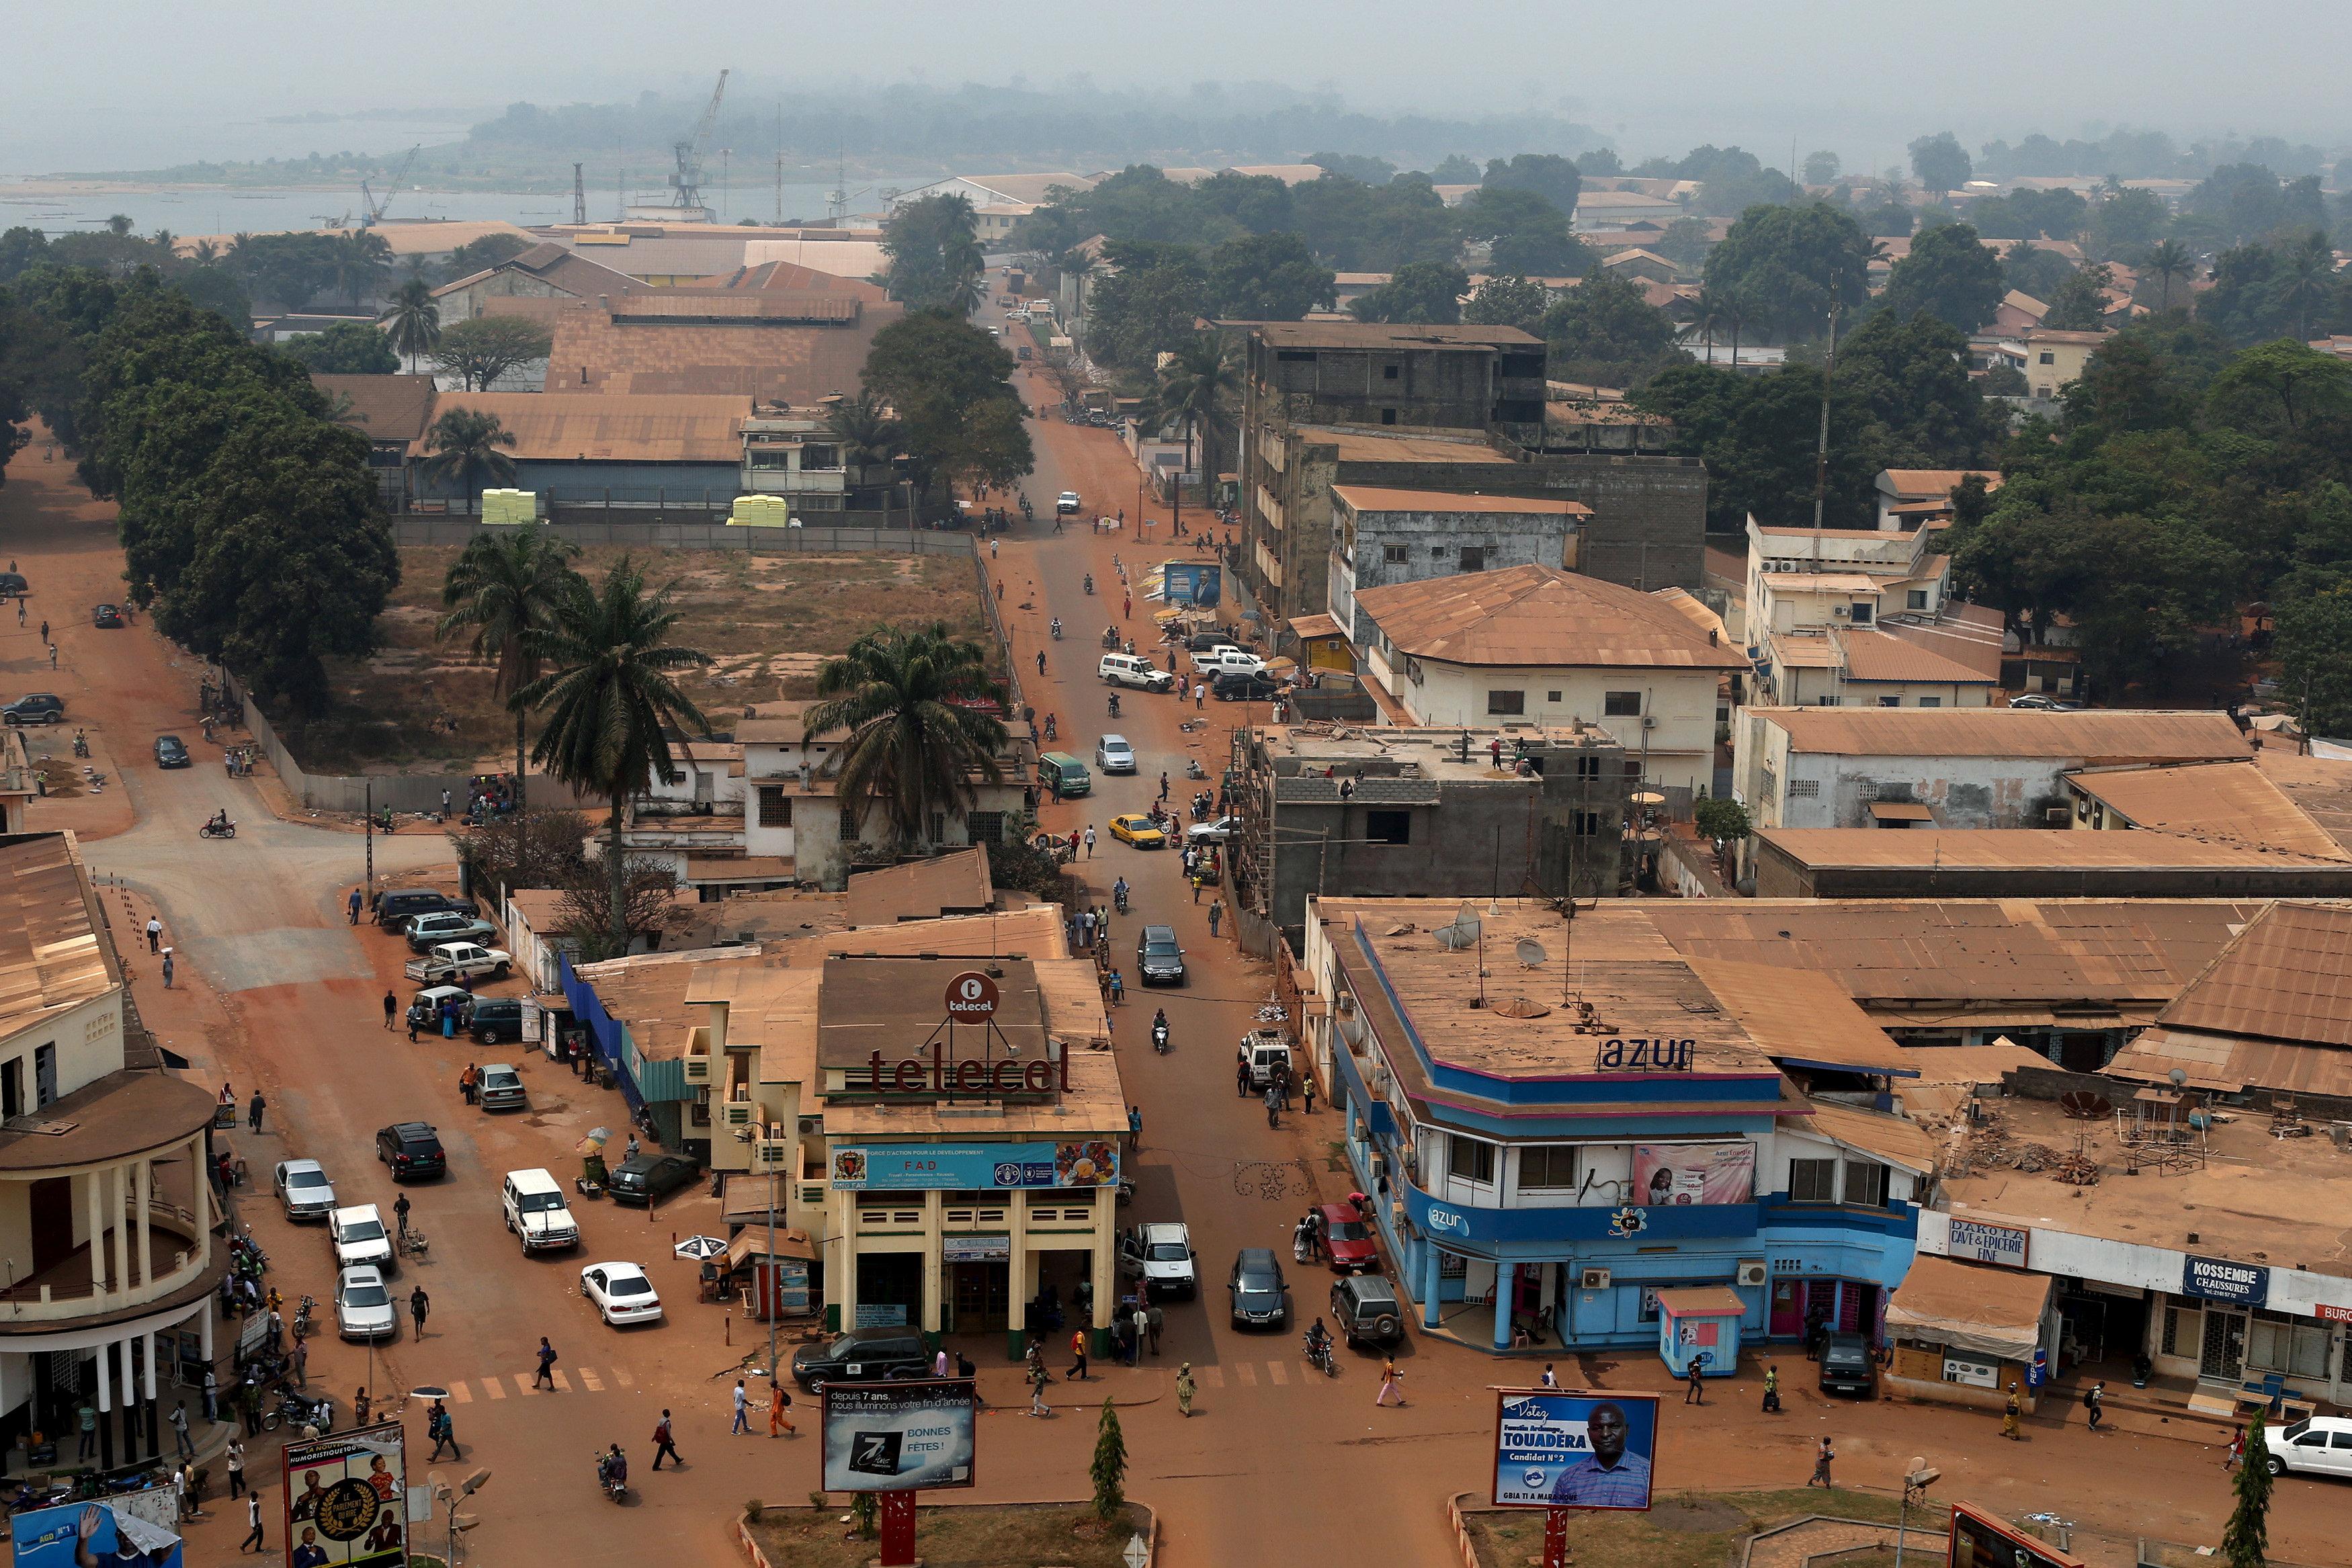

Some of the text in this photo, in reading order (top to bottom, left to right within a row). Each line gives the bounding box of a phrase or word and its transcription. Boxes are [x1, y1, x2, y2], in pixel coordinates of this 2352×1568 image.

[950, 1000, 993, 1011] telecel
[1603, 1039, 1695, 1069] azur
[868, 1041, 1073, 1093] telecel
[1432, 1209, 1461, 1227] azur
[1951, 1221, 2023, 1241] DAKOTA
[1951, 1230, 2023, 1254] CAVE & EPICERIE
[1978, 1248, 1998, 1262] FINE
[2193, 1262, 2257, 1284] KOSSEMBE
[2196, 1277, 2250, 1295] CHAUSSURES
[831, 1392, 890, 1401] depuis 7 ans,
[855, 1401, 897, 1409] illuminons
[899, 1401, 921, 1409] votre
[923, 1399, 933, 1408] fin
[935, 1397, 970, 1407] d'année
[1511, 1400, 1549, 1425] Votez
[907, 1427, 951, 1437] BONNES
[907, 1441, 939, 1452] FÊTES
[290, 1448, 343, 1464] HUMORISTIQUE
[1509, 1453, 1546, 1461] Candidat
[343, 1493, 350, 1501] LE
[333, 1499, 362, 1512] PARLEMENT
[338, 1511, 345, 1520] DU
